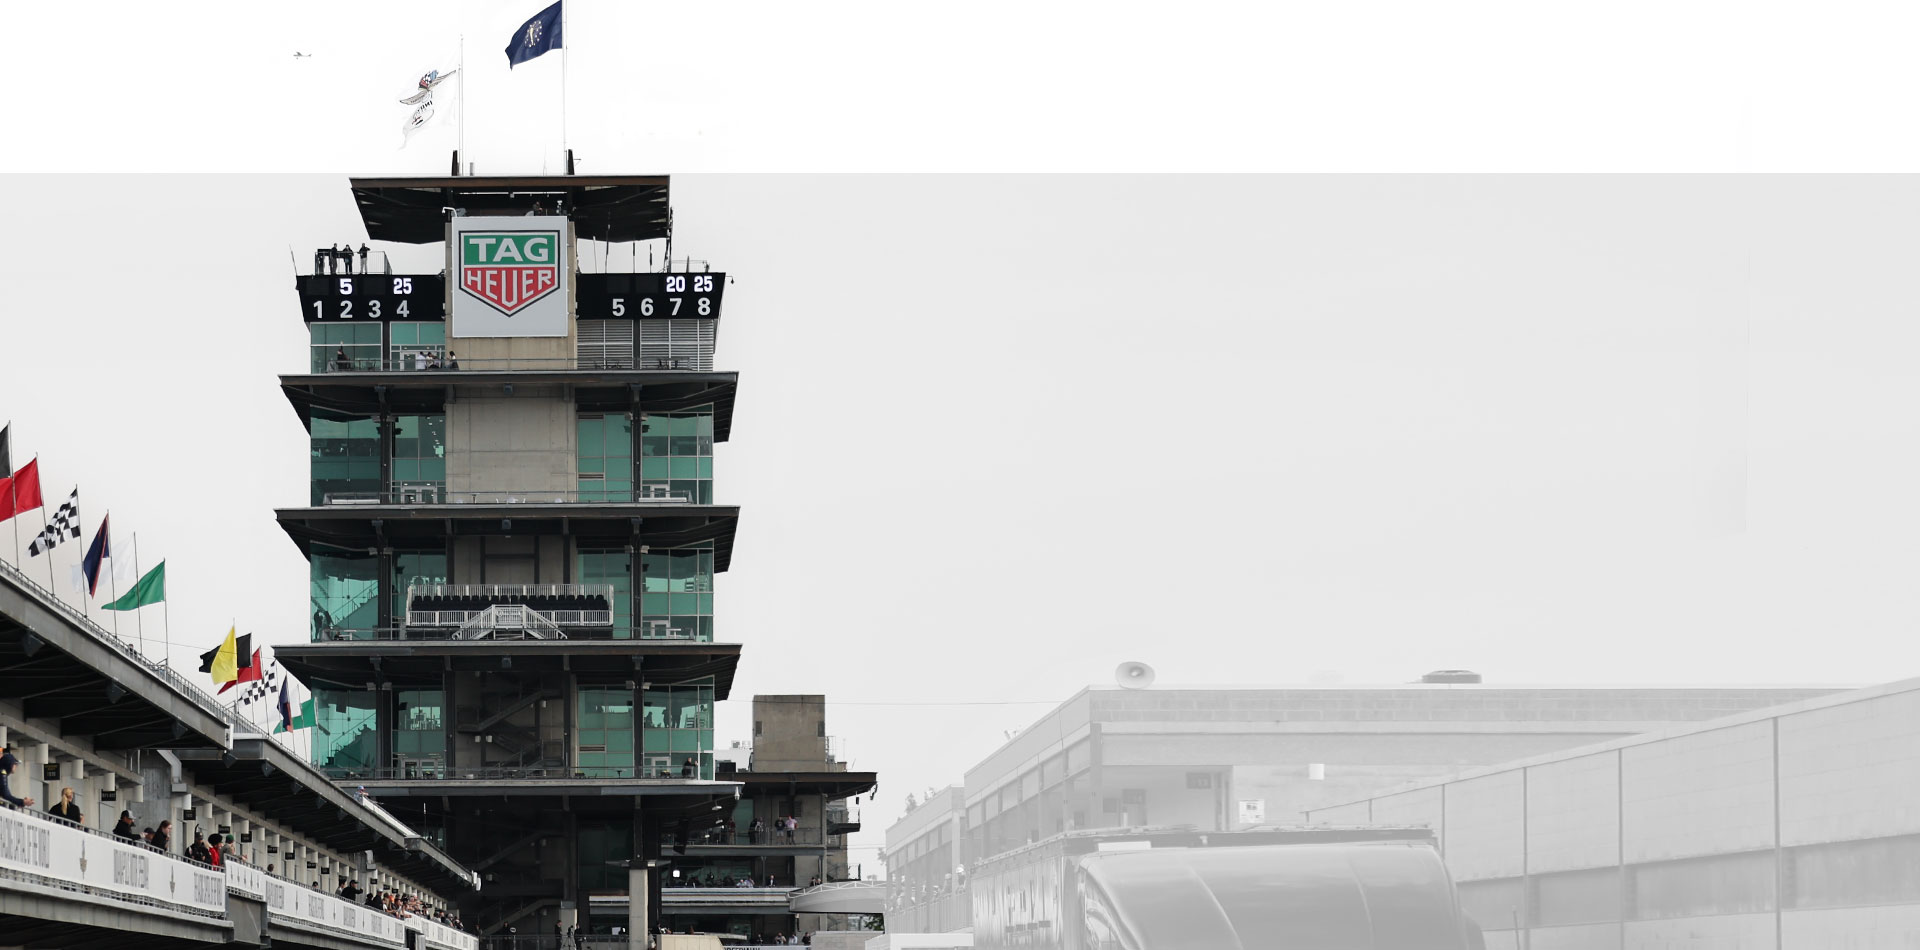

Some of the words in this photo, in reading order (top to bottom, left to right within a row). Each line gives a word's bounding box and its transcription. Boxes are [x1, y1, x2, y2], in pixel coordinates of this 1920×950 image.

[469, 237, 549, 262] TAG
[339, 277, 353, 295] 5
[393, 277, 413, 295] 25
[466, 269, 552, 308] HEUER
[666, 275, 686, 293] 20
[693, 275, 713, 293] 25
[313, 300, 323, 319] 1
[339, 299, 353, 319] 2
[368, 299, 382, 318] 3
[396, 299, 410, 318] 4
[612, 298, 626, 317] 5
[640, 297, 654, 317] 6
[669, 297, 683, 316] 7
[697, 297, 711, 316] 8
